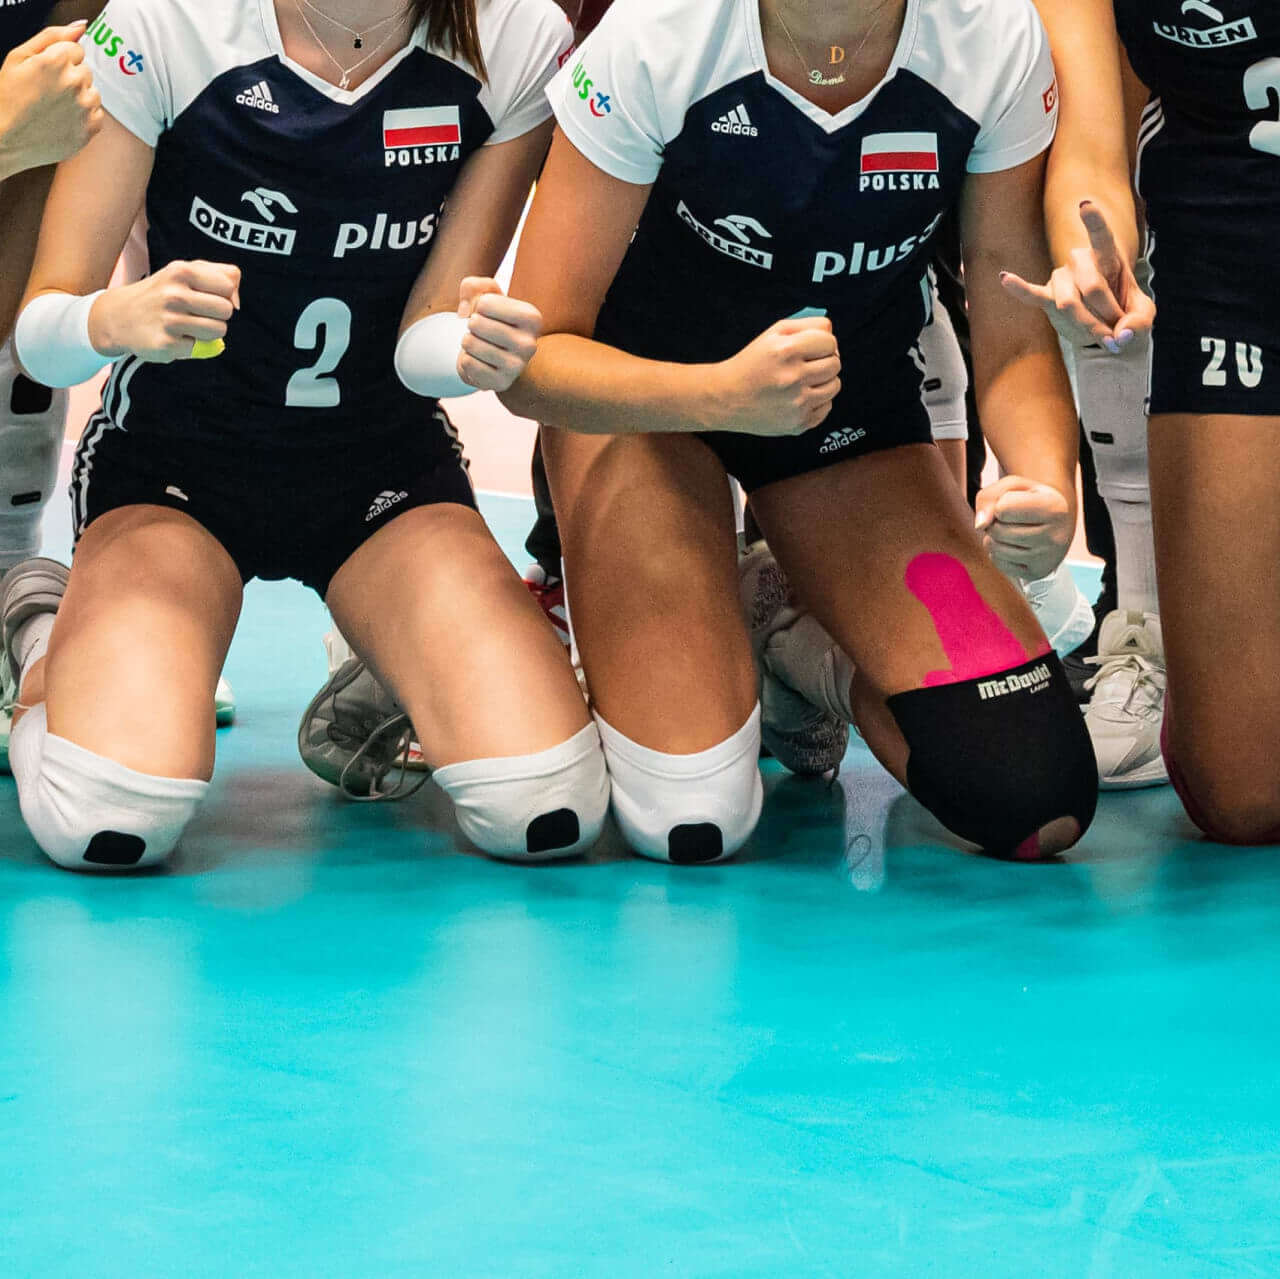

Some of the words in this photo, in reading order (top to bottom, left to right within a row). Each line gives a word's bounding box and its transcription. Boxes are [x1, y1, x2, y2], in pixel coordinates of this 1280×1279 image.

[236, 91, 280, 113] adidas
[711, 120, 758, 137] adidas
[384, 144, 461, 168] POLSKA
[859, 172, 941, 193] POLSKA
[194, 207, 291, 252] ORLEN
[332, 212, 438, 259] plus
[811, 240, 918, 284] plus
[285, 296, 353, 408] 2
[819, 426, 868, 455] adidas
[365, 490, 409, 521] adidas
[976, 662, 1053, 700] McDavid
